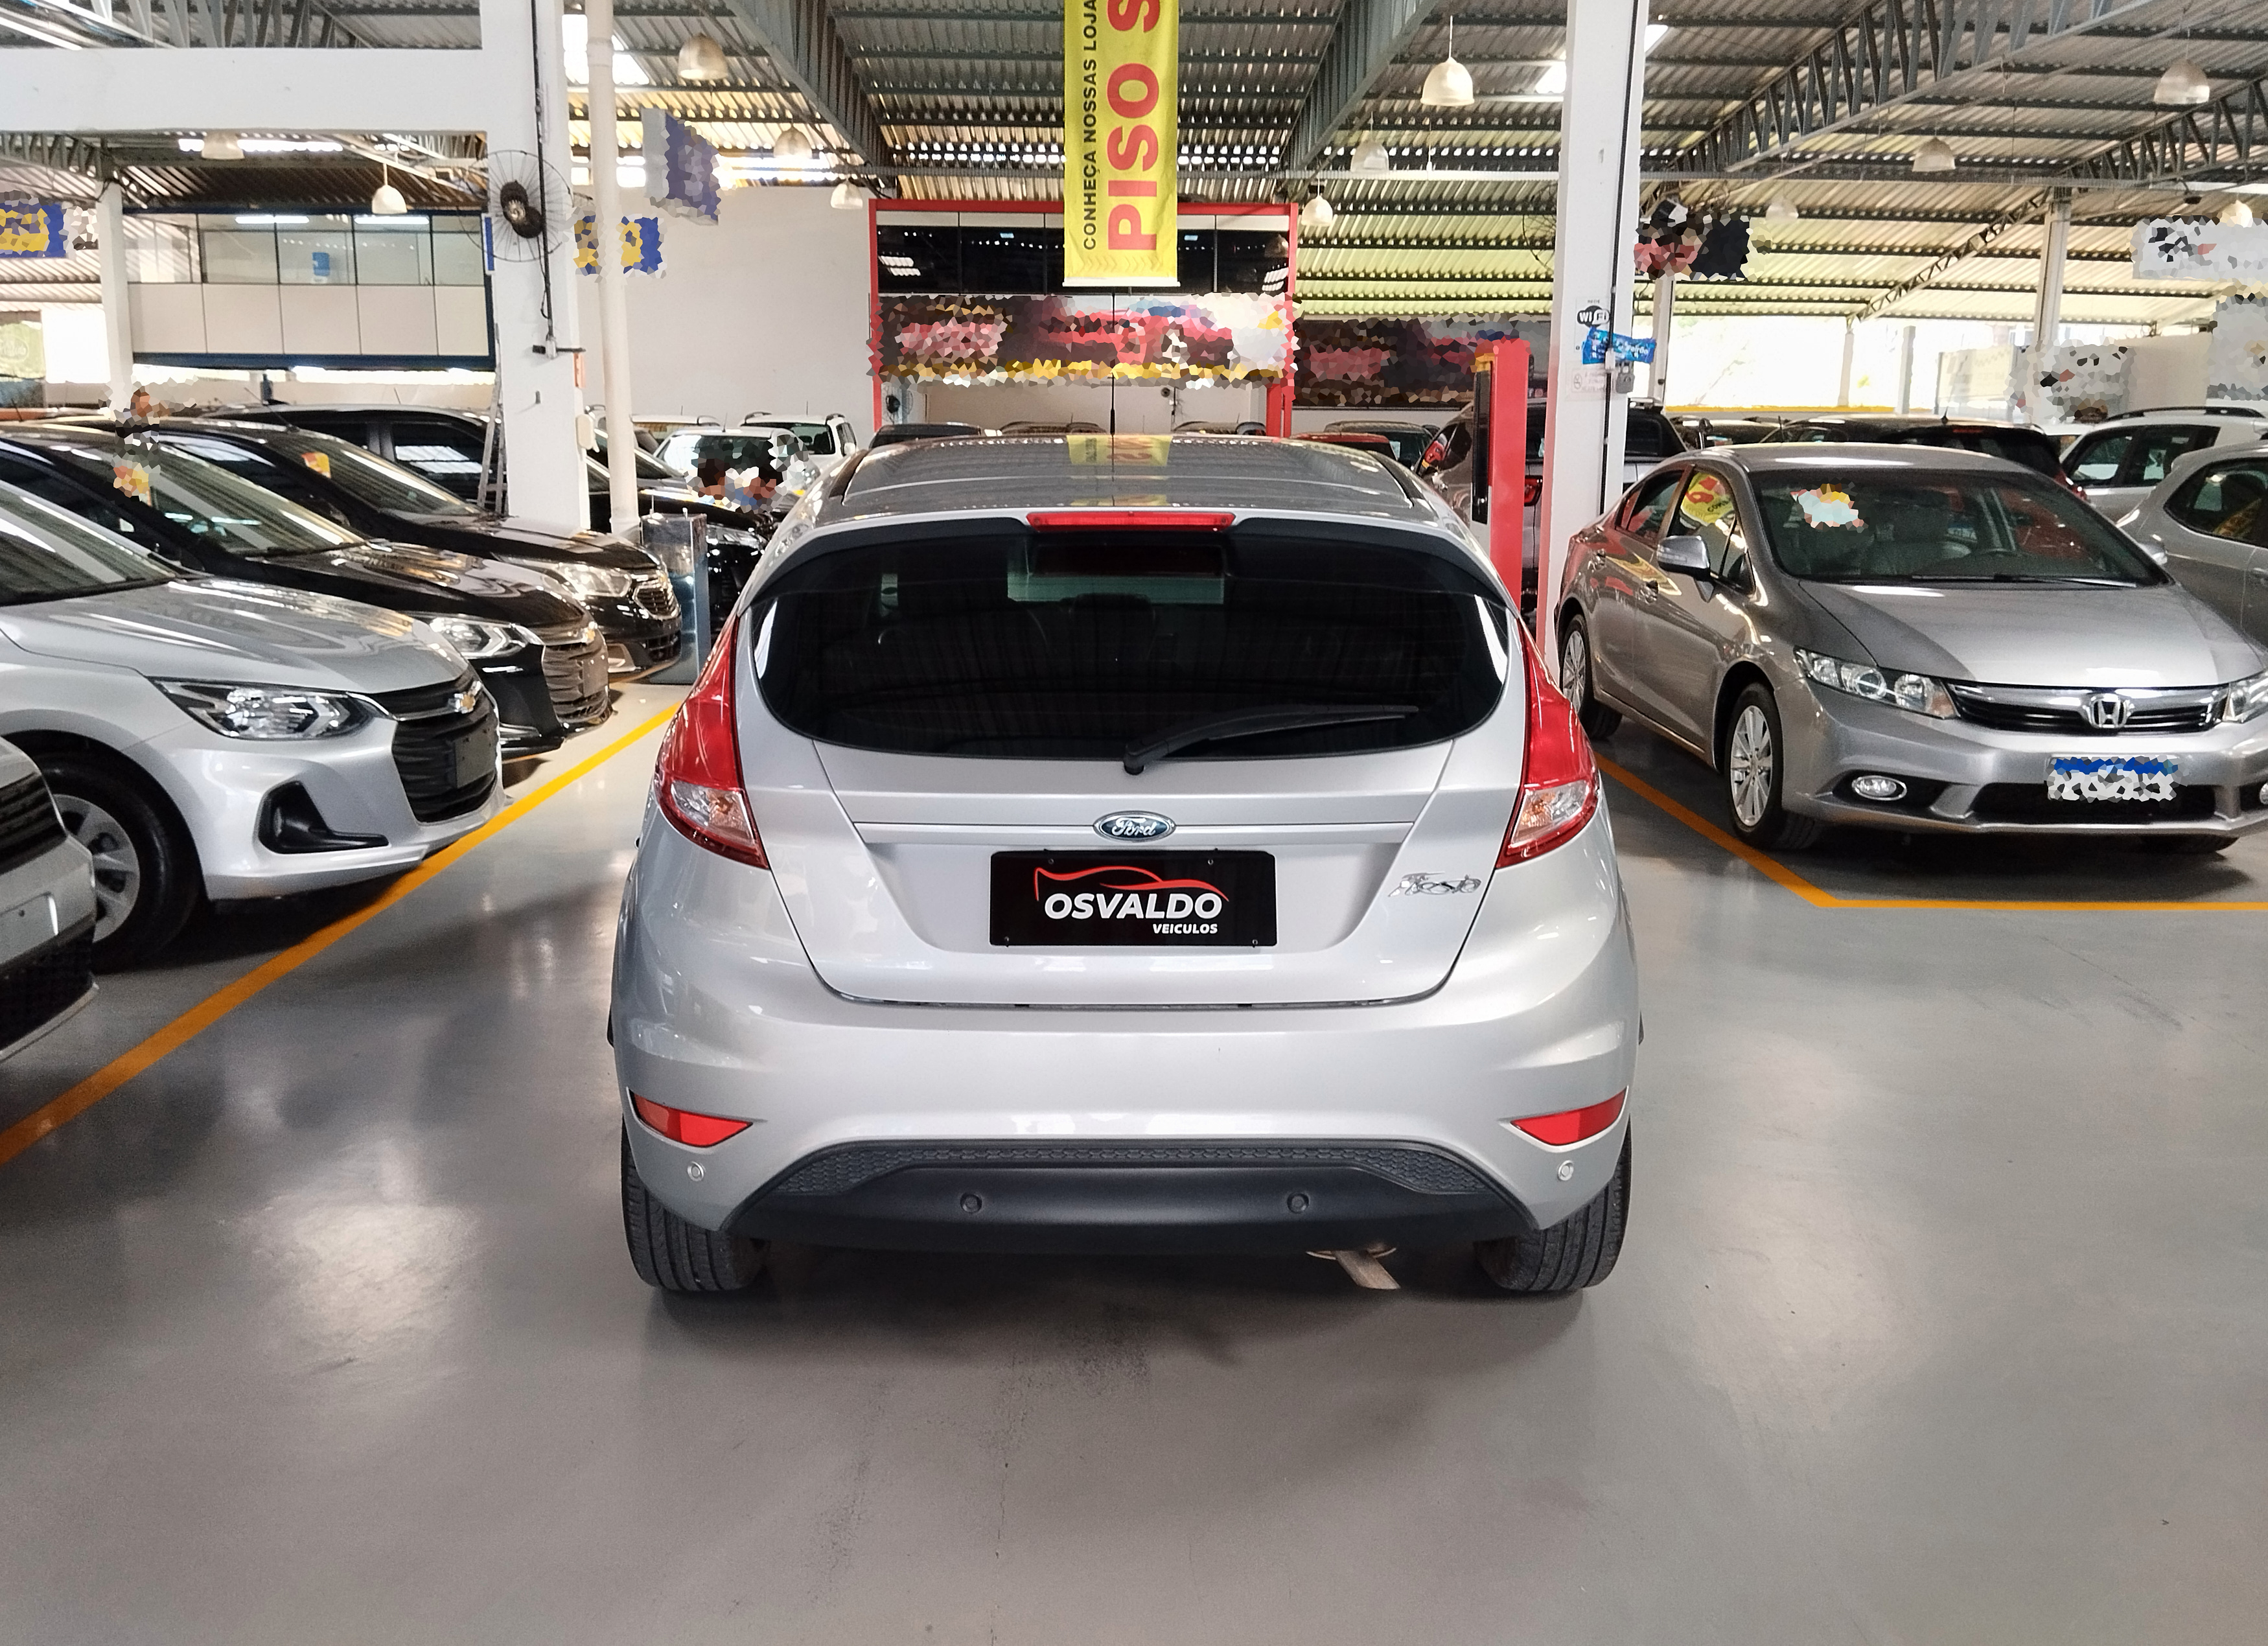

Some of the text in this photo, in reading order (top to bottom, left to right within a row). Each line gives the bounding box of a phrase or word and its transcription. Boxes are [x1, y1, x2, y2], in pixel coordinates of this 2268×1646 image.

[1083, 59, 1097, 143] NOSSAS
[1106, 63, 1159, 250] PISO
[1083, 150, 1100, 250] CONHEÇA
[1111, 817, 1158, 837] Ford
[1044, 892, 1223, 920] OSVALDO
[1152, 923, 1218, 934] VEICULOS
